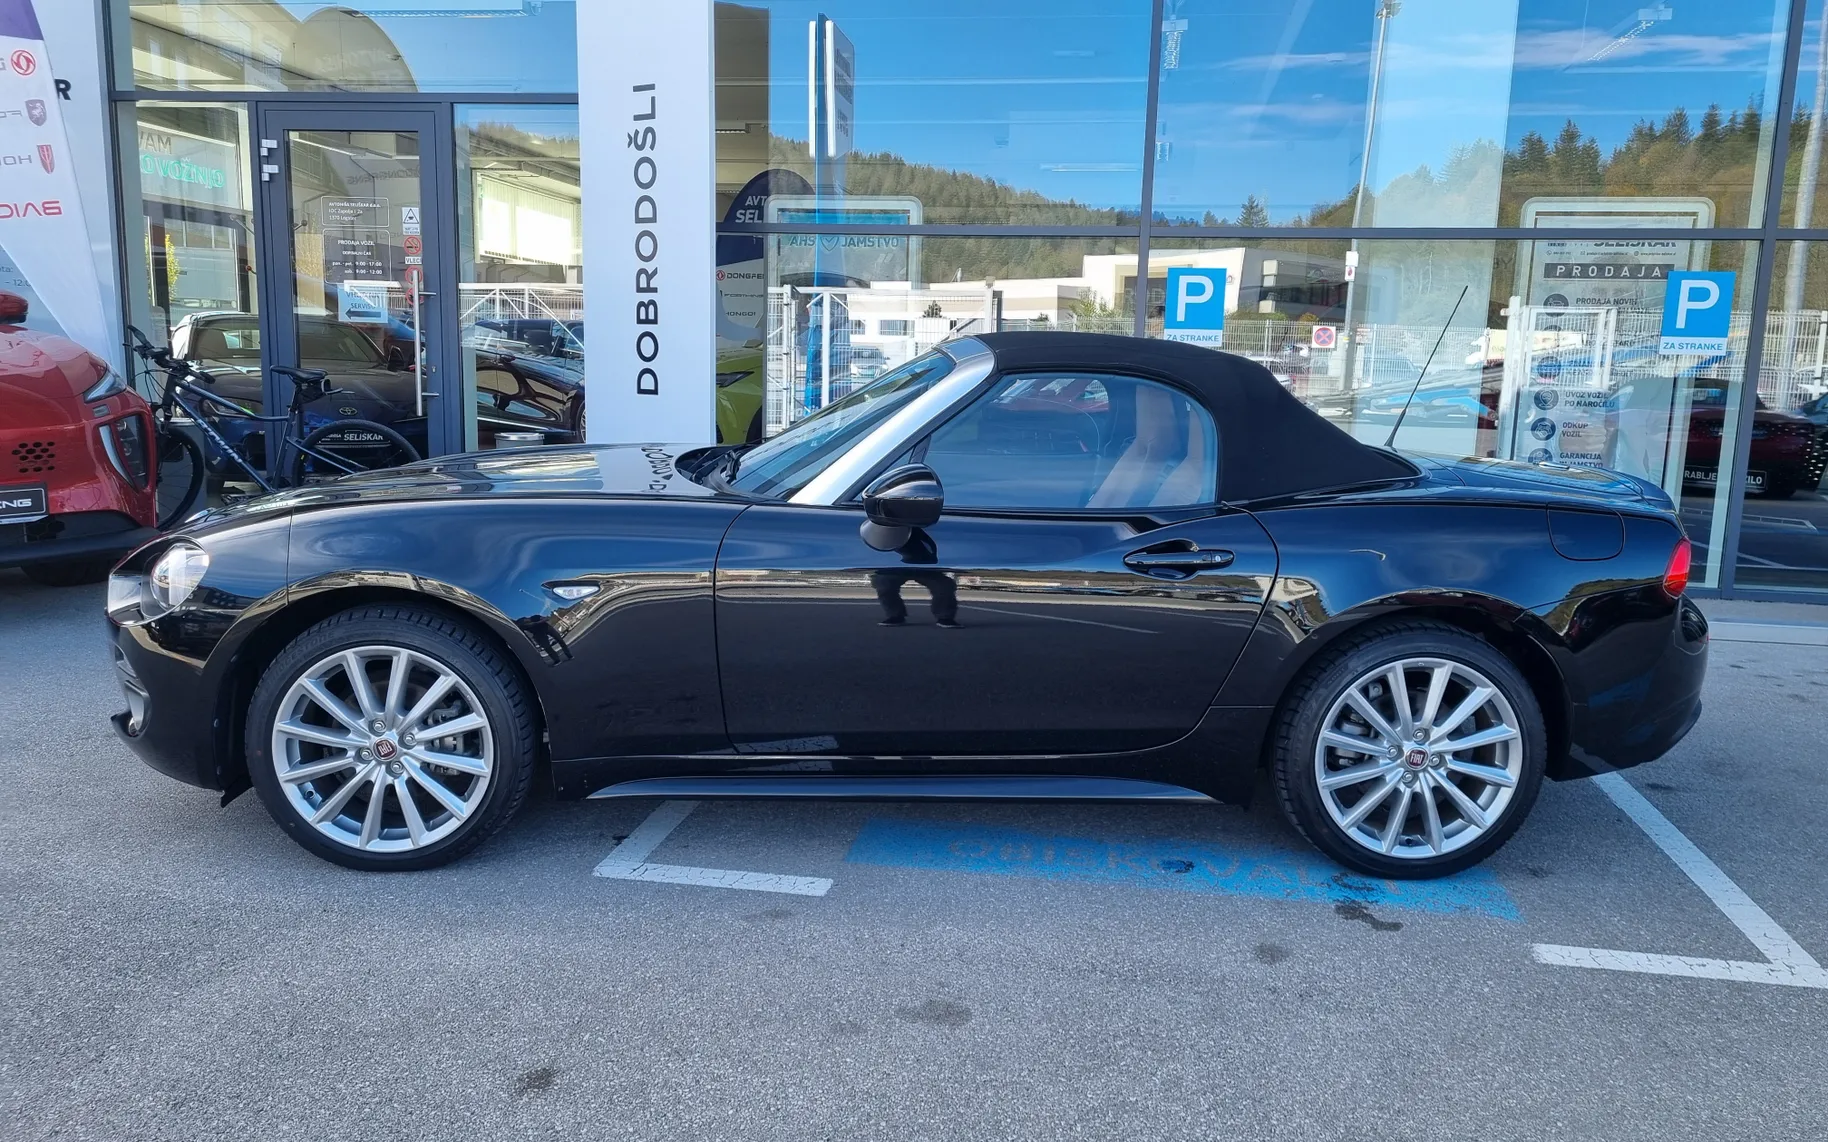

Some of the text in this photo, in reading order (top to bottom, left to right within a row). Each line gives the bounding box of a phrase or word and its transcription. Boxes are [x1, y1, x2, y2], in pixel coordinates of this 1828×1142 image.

[745, 195, 768, 206] AVT
[735, 209, 763, 224] SEL
[628, 83, 659, 396] DOBRODOŠLI
[790, 236, 899, 248] AHS JAMSTVO
[726, 272, 765, 280] DONGFE
[1556, 265, 1662, 277] PRODAJA
[1176, 275, 1214, 322] P
[1576, 297, 1638, 306] PRODAJA NOVIH
[1675, 279, 1720, 329] P
[1166, 333, 1220, 342] ZA STRANKE
[1663, 342, 1723, 351] ZA STRANKE
[1565, 391, 1586, 399] UVOZ
[1562, 421, 1589, 429] ODKUP
[1561, 430, 1583, 438] VOZIL
[1559, 452, 1602, 460] GARANCIJA
[1684, 470, 1718, 481] RABLJE
[1410, 752, 1424, 764] FIAT
